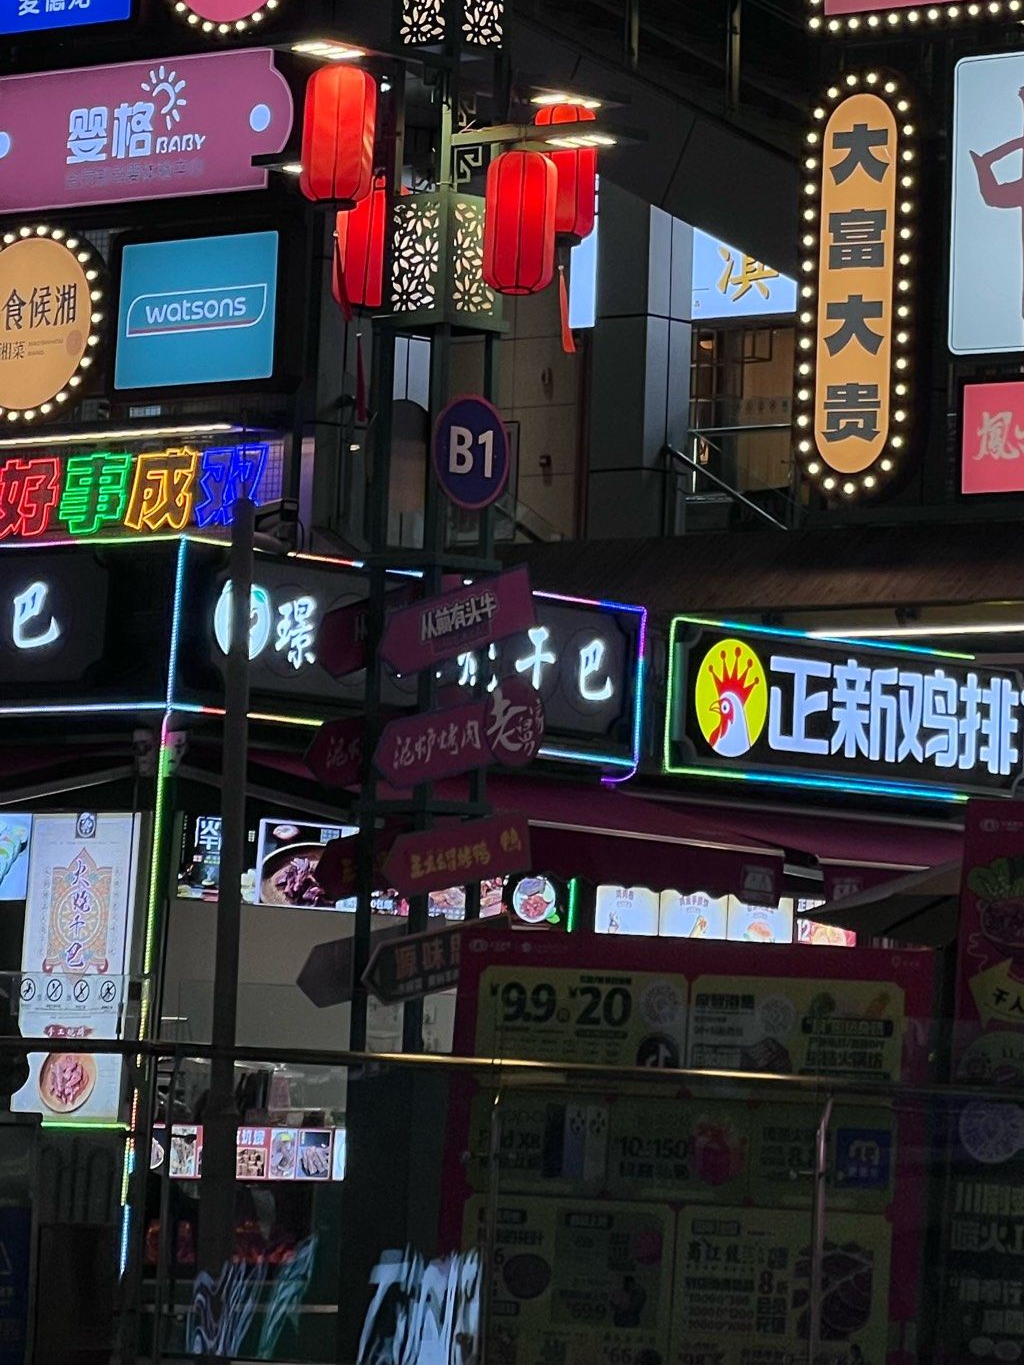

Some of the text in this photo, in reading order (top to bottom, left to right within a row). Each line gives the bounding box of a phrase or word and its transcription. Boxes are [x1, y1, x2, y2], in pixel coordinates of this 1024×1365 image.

[156, 134, 207, 155] BABY
[1, 283, 77, 331] 食候湘
[146, 296, 246, 325] watsons
[820, 123, 890, 444] 大富大贵
[448, 425, 495, 479] B1
[0, 443, 269, 536] 好事成双
[13, 581, 61, 649] 巴
[420, 592, 498, 642] 从前有头牛
[768, 654, 1020, 776] 正新鸡排
